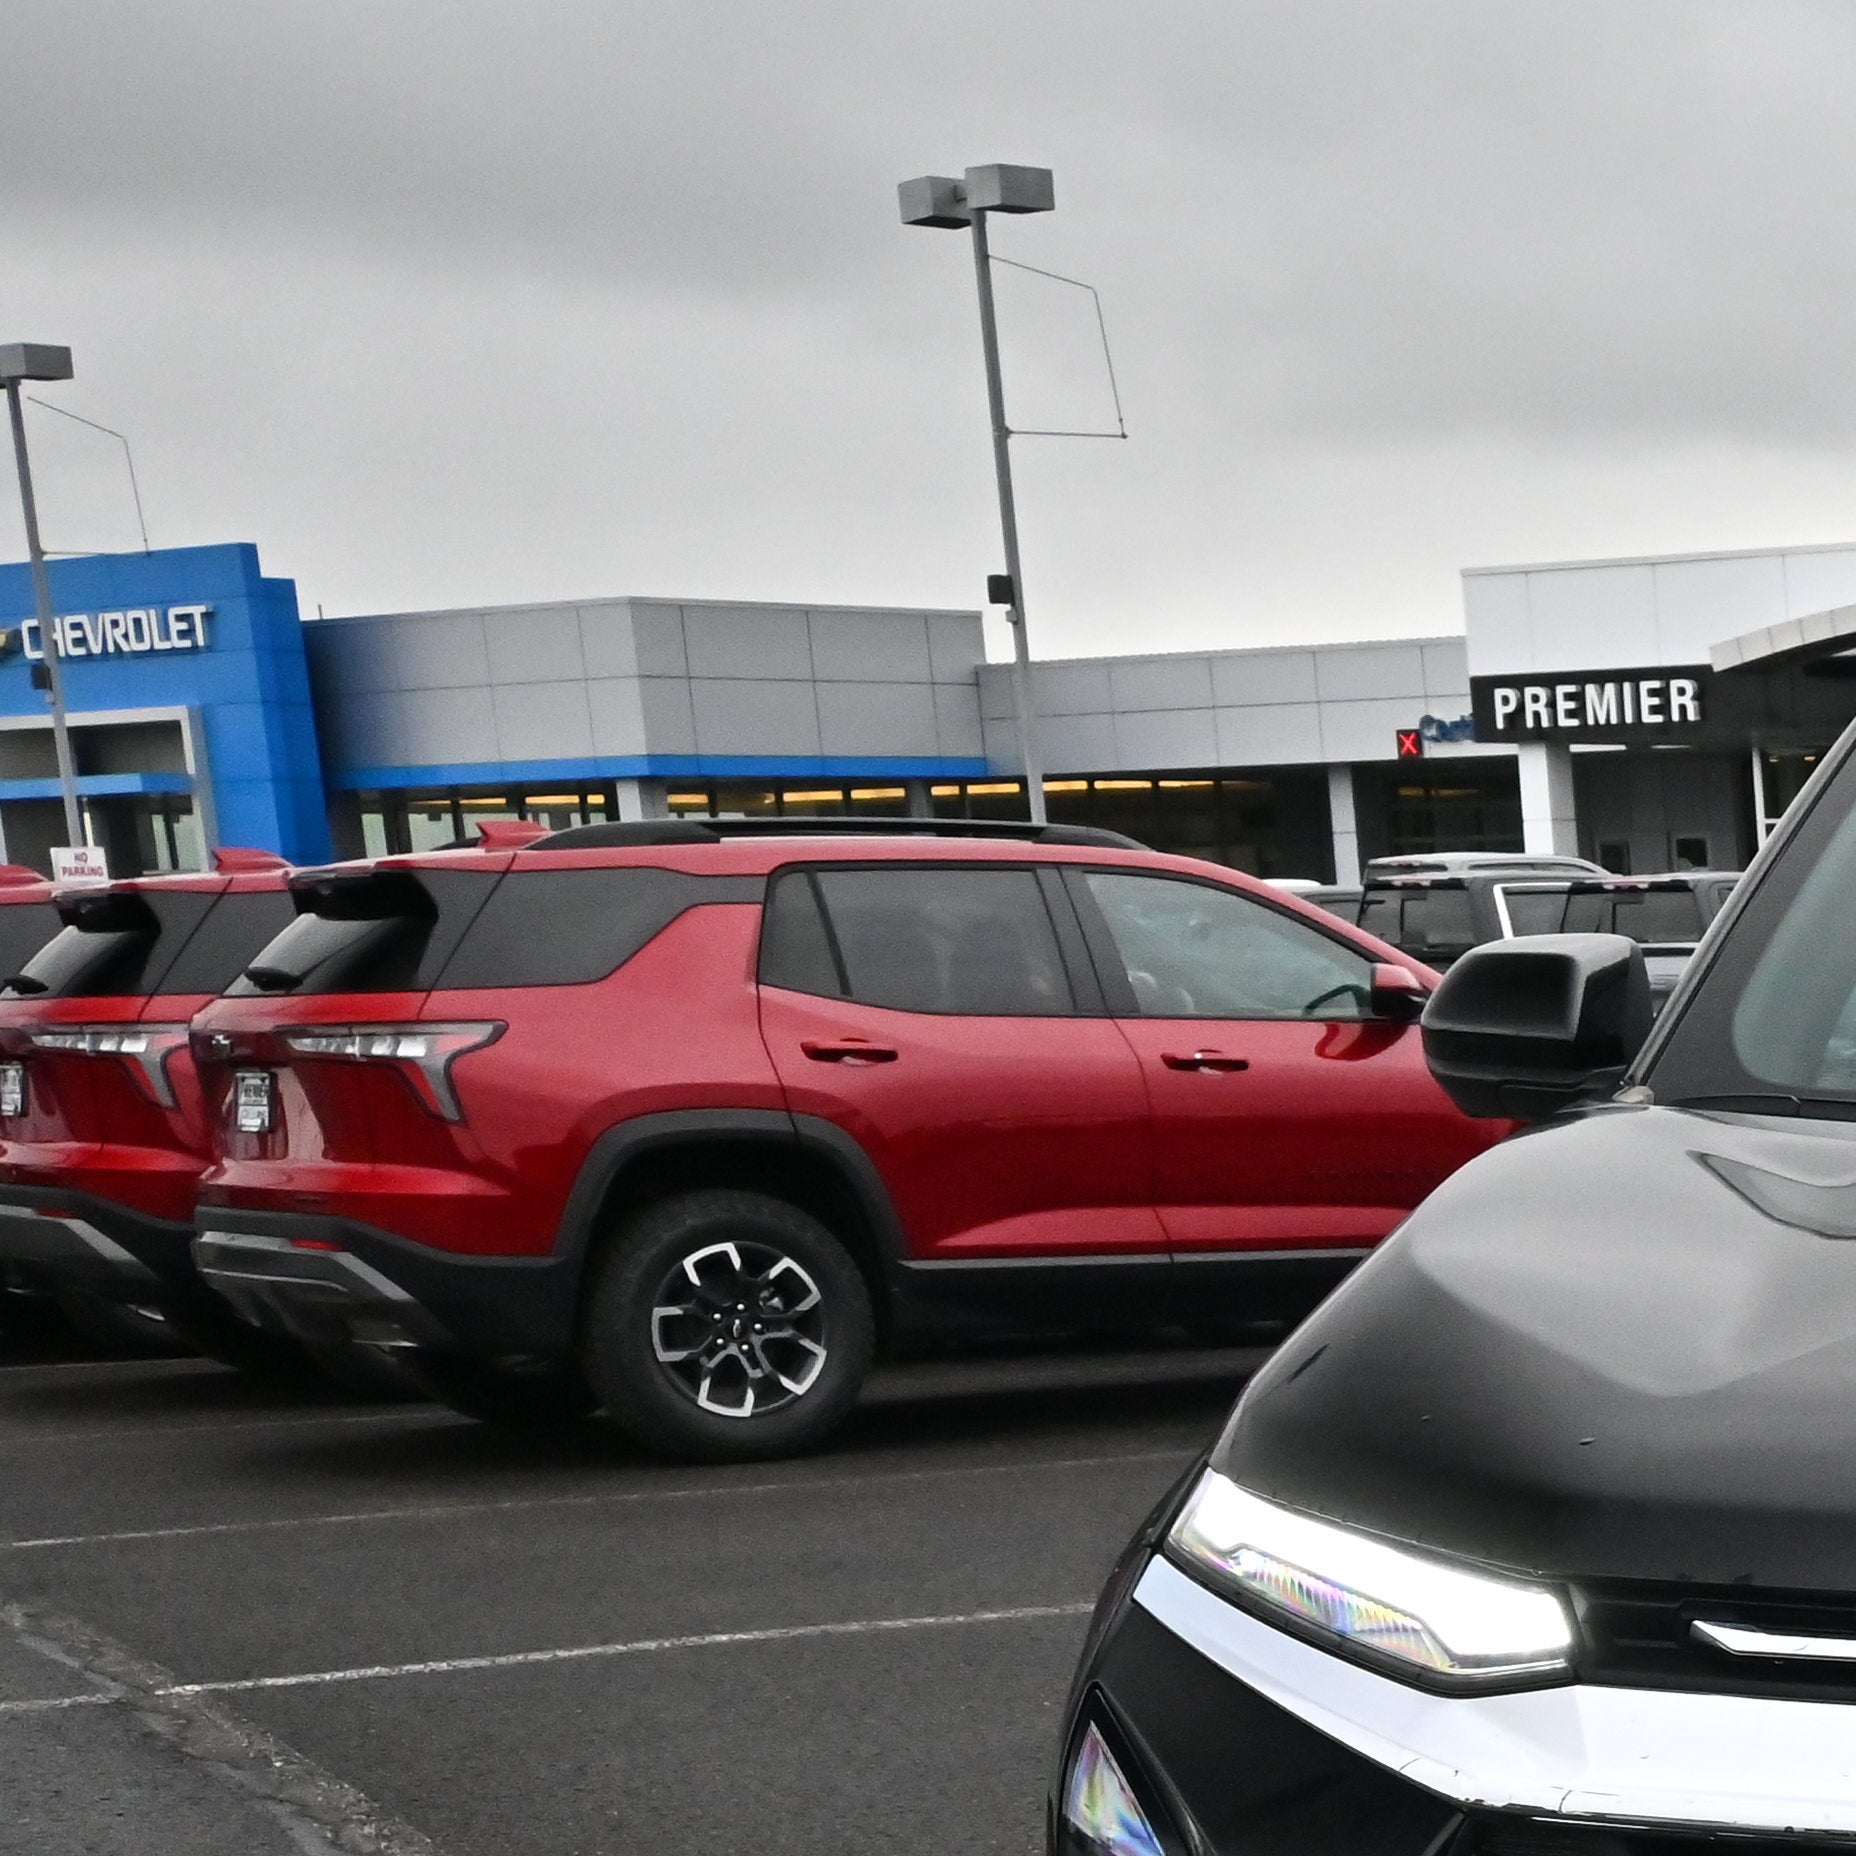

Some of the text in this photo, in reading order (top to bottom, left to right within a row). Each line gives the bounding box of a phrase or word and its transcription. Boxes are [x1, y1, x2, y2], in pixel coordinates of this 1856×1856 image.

[22, 605, 207, 660] CHEVROLET
[1493, 679, 1699, 730] PREMIER
[62, 865, 104, 877] PARKING
[74, 852, 88, 864] NO
